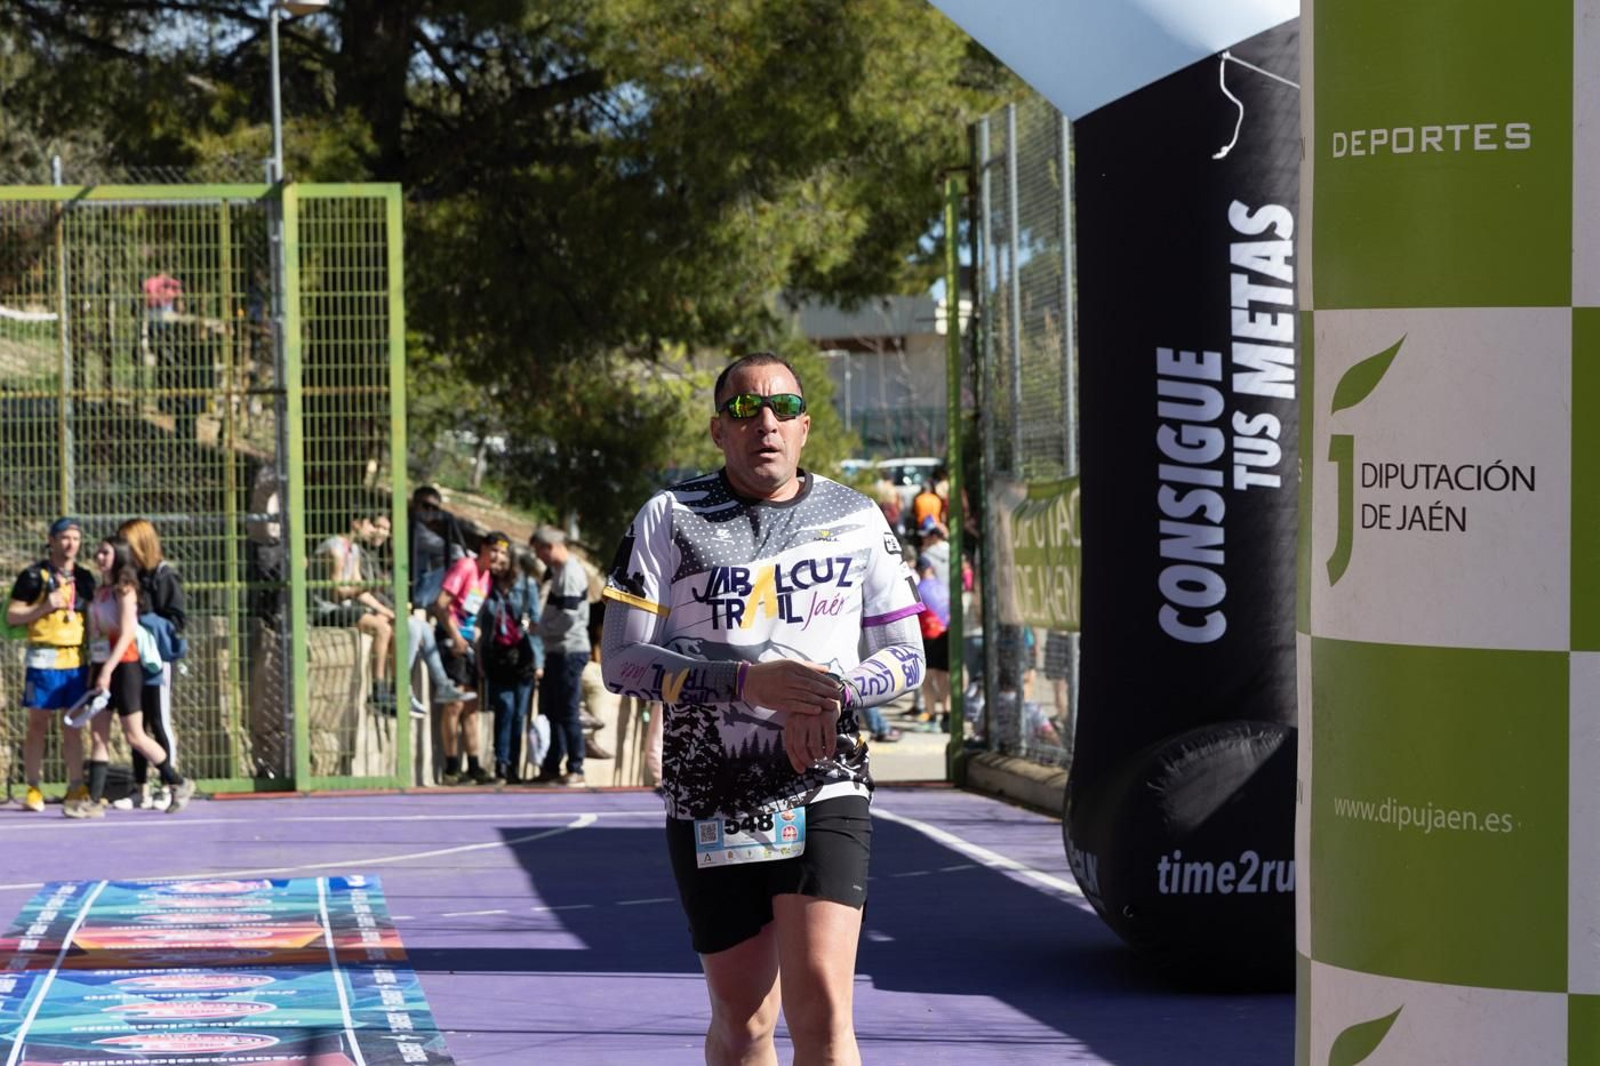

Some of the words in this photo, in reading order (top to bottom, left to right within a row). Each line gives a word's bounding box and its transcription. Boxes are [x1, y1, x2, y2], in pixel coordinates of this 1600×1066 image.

[1333, 122, 1532, 158] DEPORTES
[1228, 200, 1296, 399] METAS
[1232, 410, 1281, 490] TUS
[1157, 347, 1227, 643] CONSIGUE
[1361, 459, 1536, 492] DIPUTACIÓN
[1361, 503, 1391, 530] DE
[1396, 500, 1467, 532] JAÉN
[692, 557, 853, 603] JABALCUZ
[1334, 797, 1513, 834] www.dipujaen.es
[1157, 849, 1295, 894] time2ru
